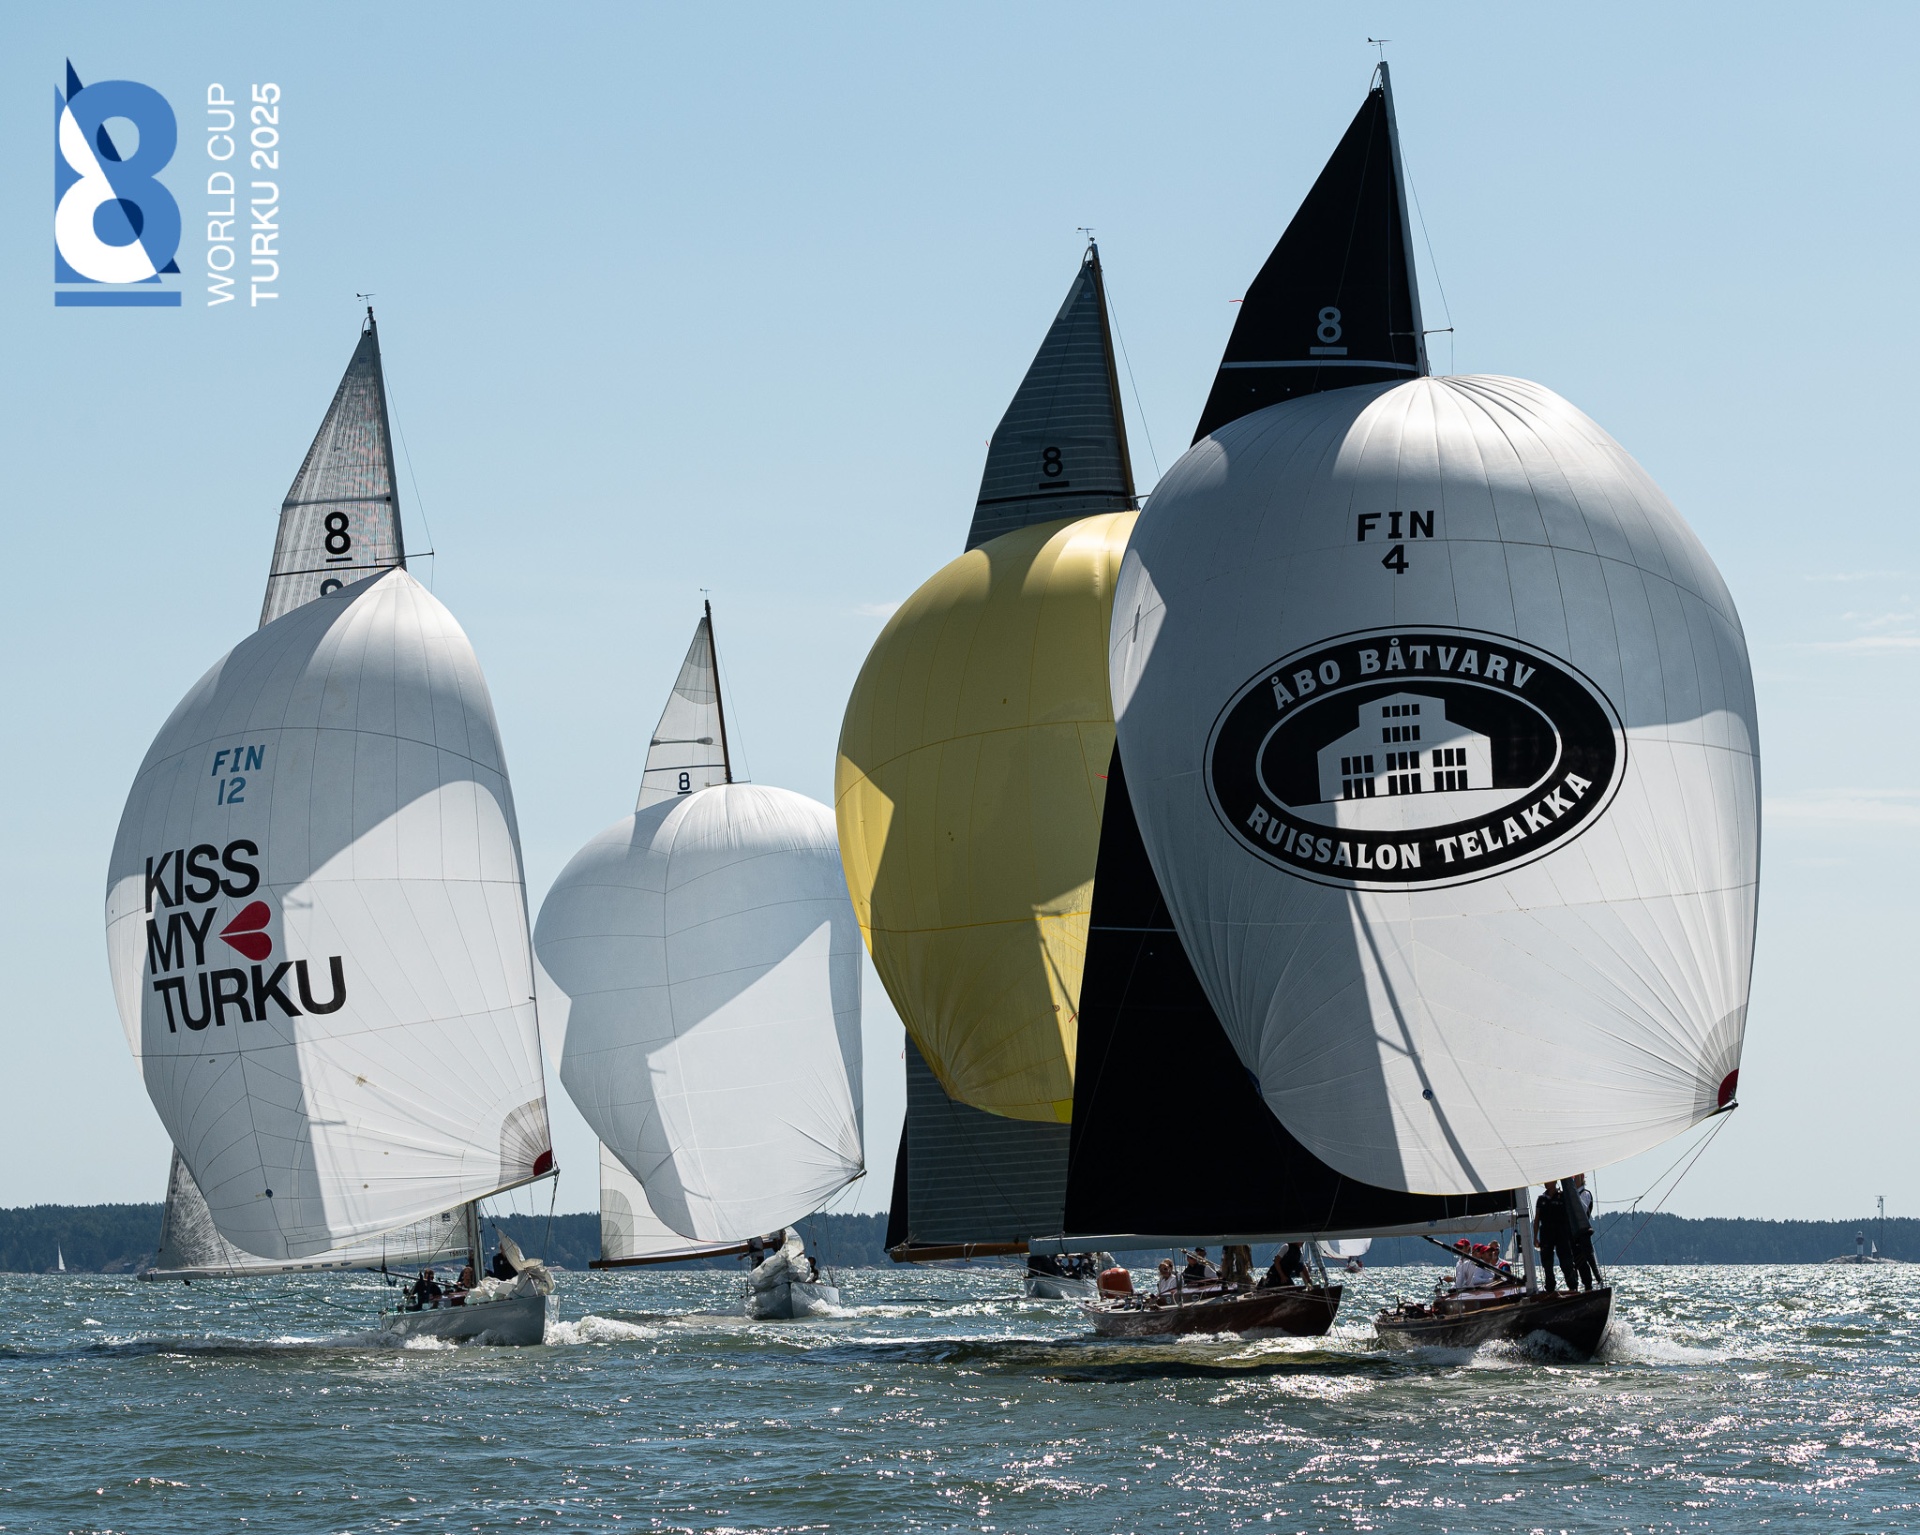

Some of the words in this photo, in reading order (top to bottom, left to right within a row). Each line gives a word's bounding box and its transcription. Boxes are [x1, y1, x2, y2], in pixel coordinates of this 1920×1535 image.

[1316, 306, 1343, 344] 8
[1042, 446, 1064, 478] 8
[324, 511, 352, 555] 8
[1357, 510, 1435, 542] FIN
[1381, 544, 1410, 575] 4
[1270, 658, 1342, 711] ÅBO
[1358, 637, 1537, 690] BÅTVARV
[211, 744, 265, 777] FIN
[217, 776, 247, 806] 12
[678, 771, 691, 791] 8
[1246, 803, 1422, 871] RUISSALON
[1435, 771, 1593, 864] TELAKKA
[145, 839, 261, 914] KISS
[146, 907, 218, 975] MY
[153, 956, 347, 1034] TURKU
